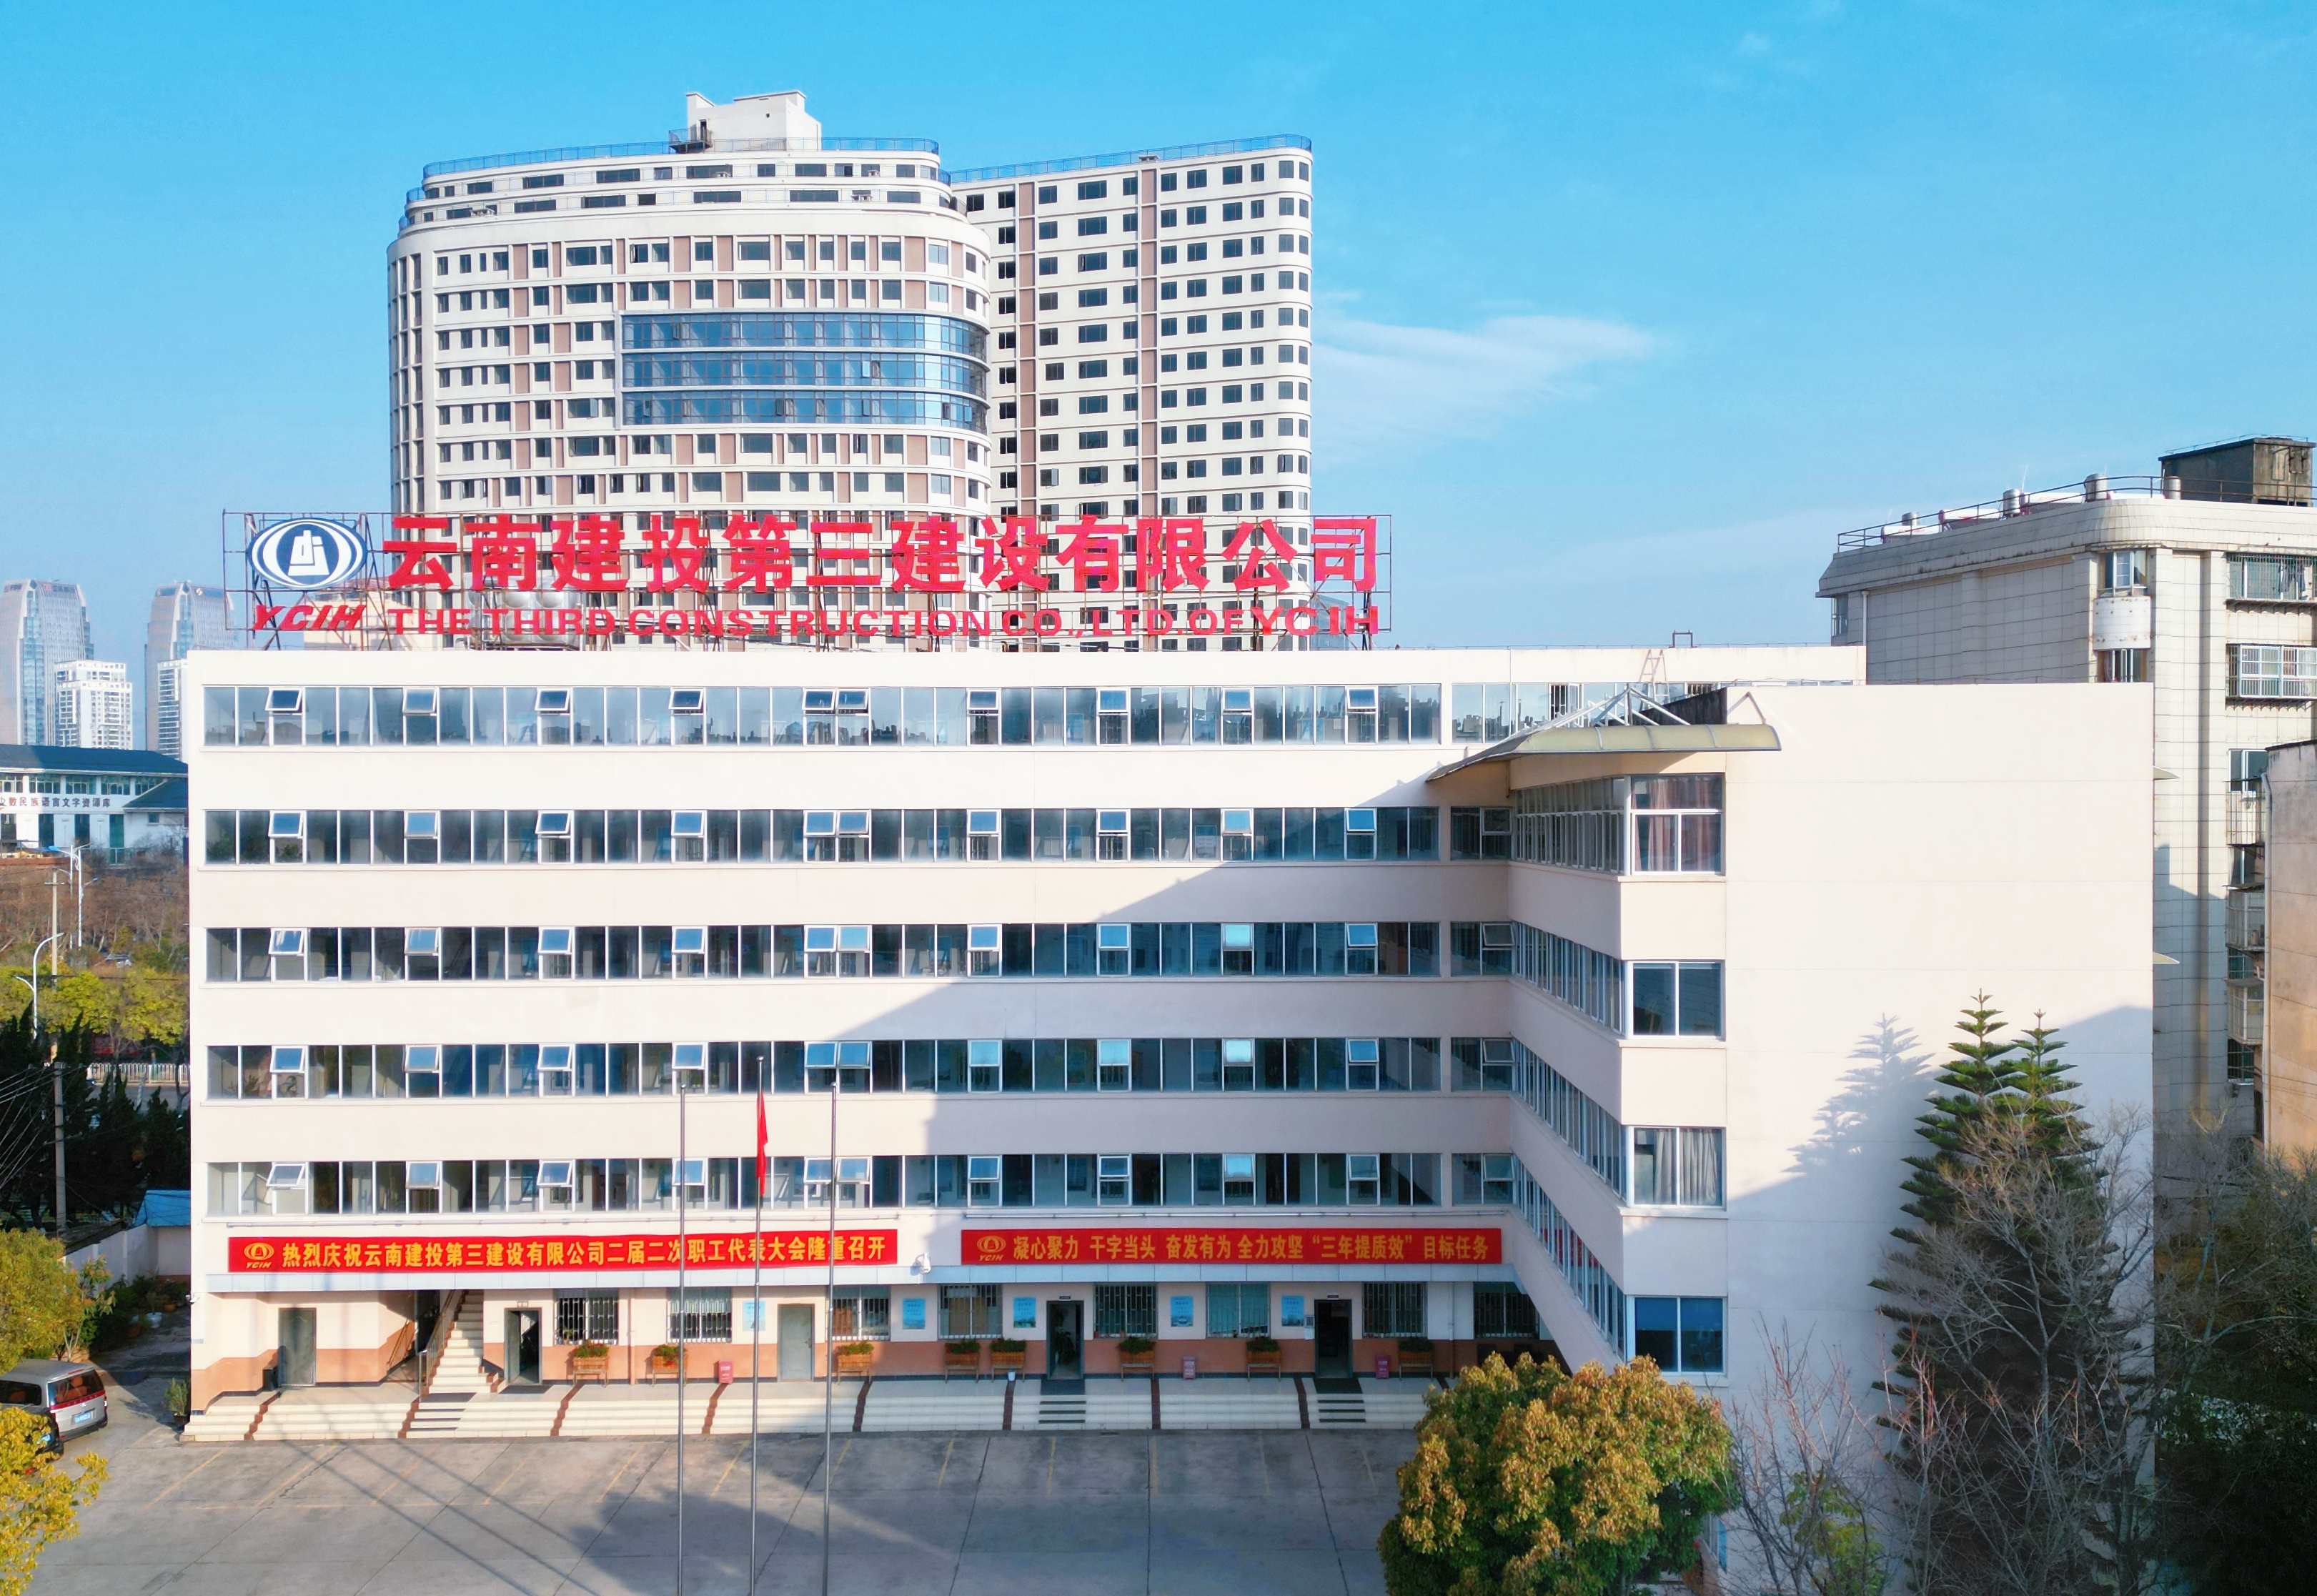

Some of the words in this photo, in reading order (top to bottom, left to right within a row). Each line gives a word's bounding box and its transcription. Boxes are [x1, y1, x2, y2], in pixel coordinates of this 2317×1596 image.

[382, 514, 1376, 593] 云南建投第三建设有限公司
[252, 604, 367, 631] YCIH
[387, 608, 472, 635] THE
[483, 608, 616, 635] THIRD
[627, 608, 991, 637] CONSTRUCTION
[1189, 608, 1244, 635] OF
[1251, 605, 1379, 636] YCIH
[282, 1236, 886, 1268] 热烈庆祝云南建投第三建设有限公司二届二次职工代表大会隆重召开
[1013, 1234, 1078, 1260] 凝心聚力
[1089, 1234, 1156, 1260] 干字当头
[1166, 1234, 1231, 1259] 奋发有为
[1238, 1234, 1304, 1259] 全力攻坚
[1424, 1234, 1489, 1261] 目标任务
